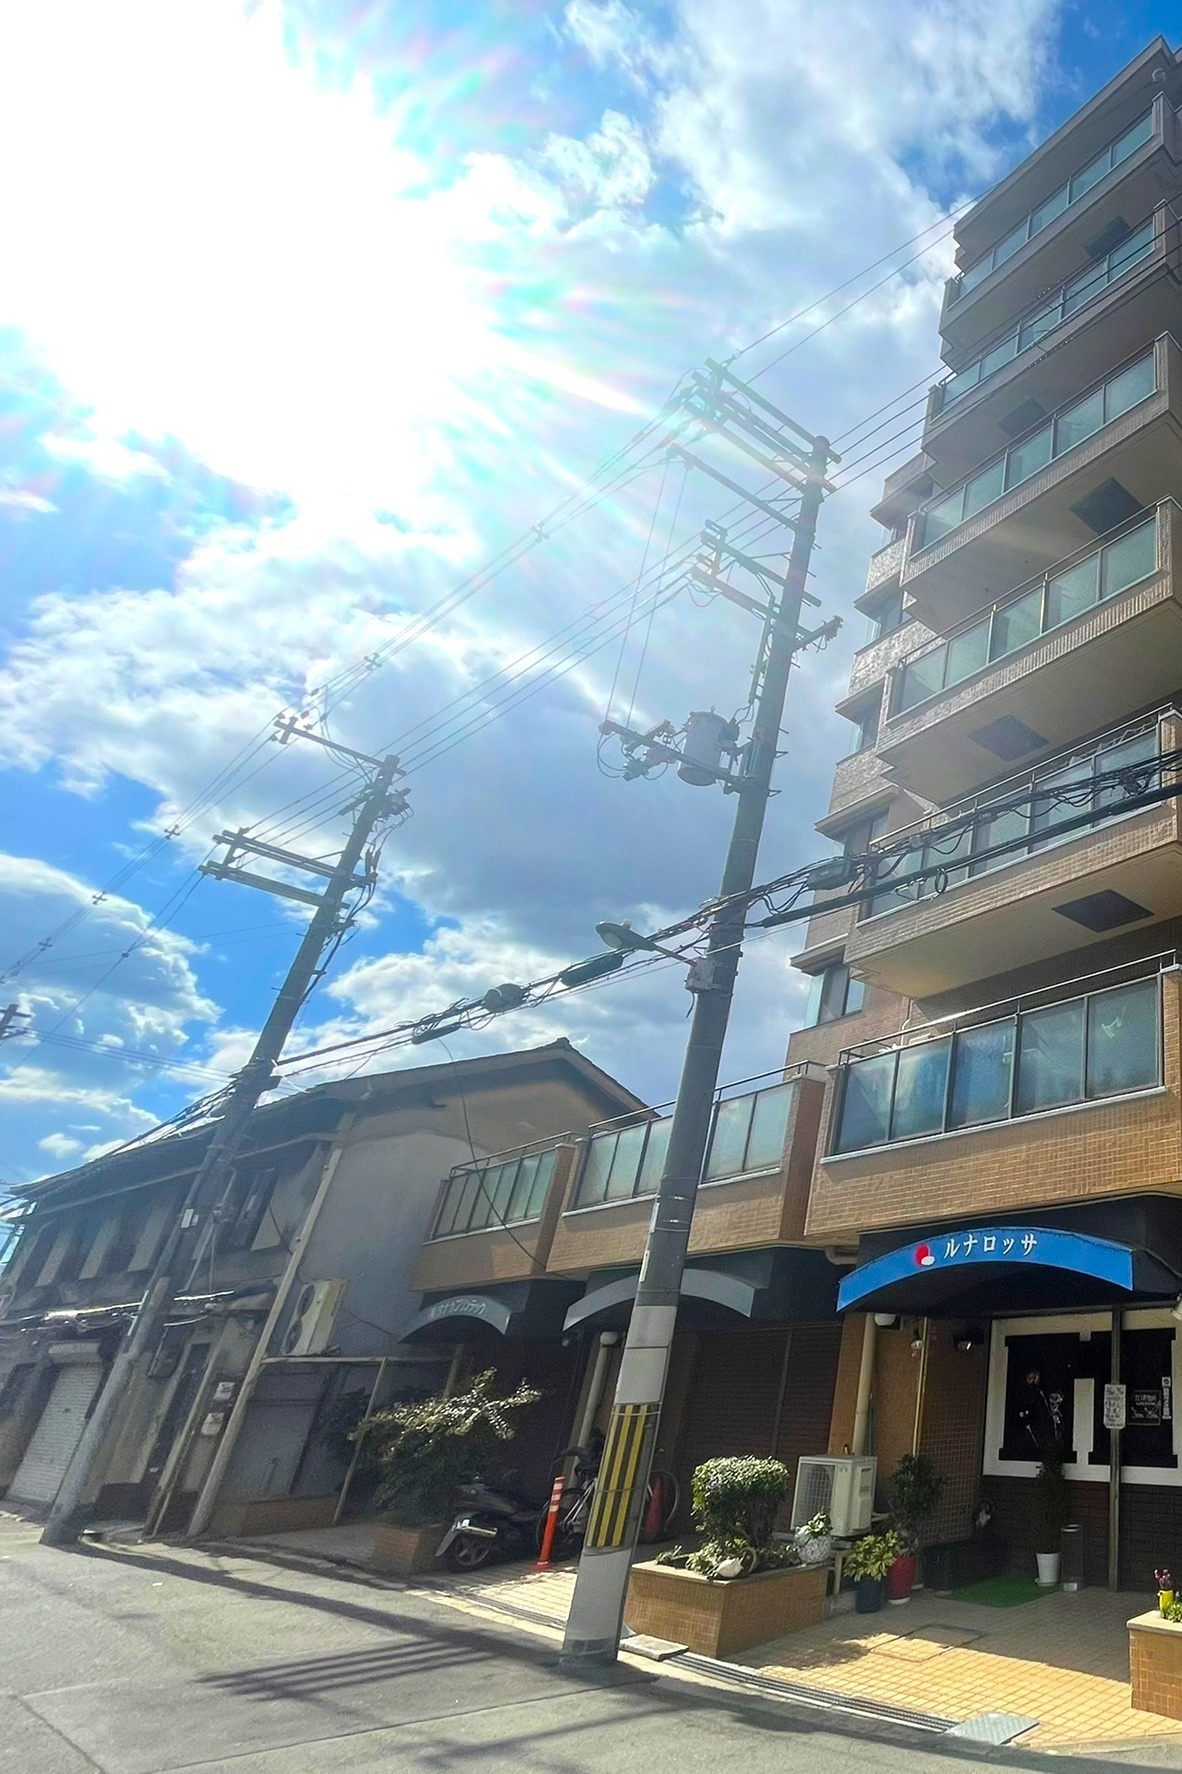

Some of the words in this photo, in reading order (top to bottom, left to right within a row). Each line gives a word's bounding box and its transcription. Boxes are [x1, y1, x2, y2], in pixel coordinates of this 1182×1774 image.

[943, 1233, 1038, 1259] ルナロッサ
